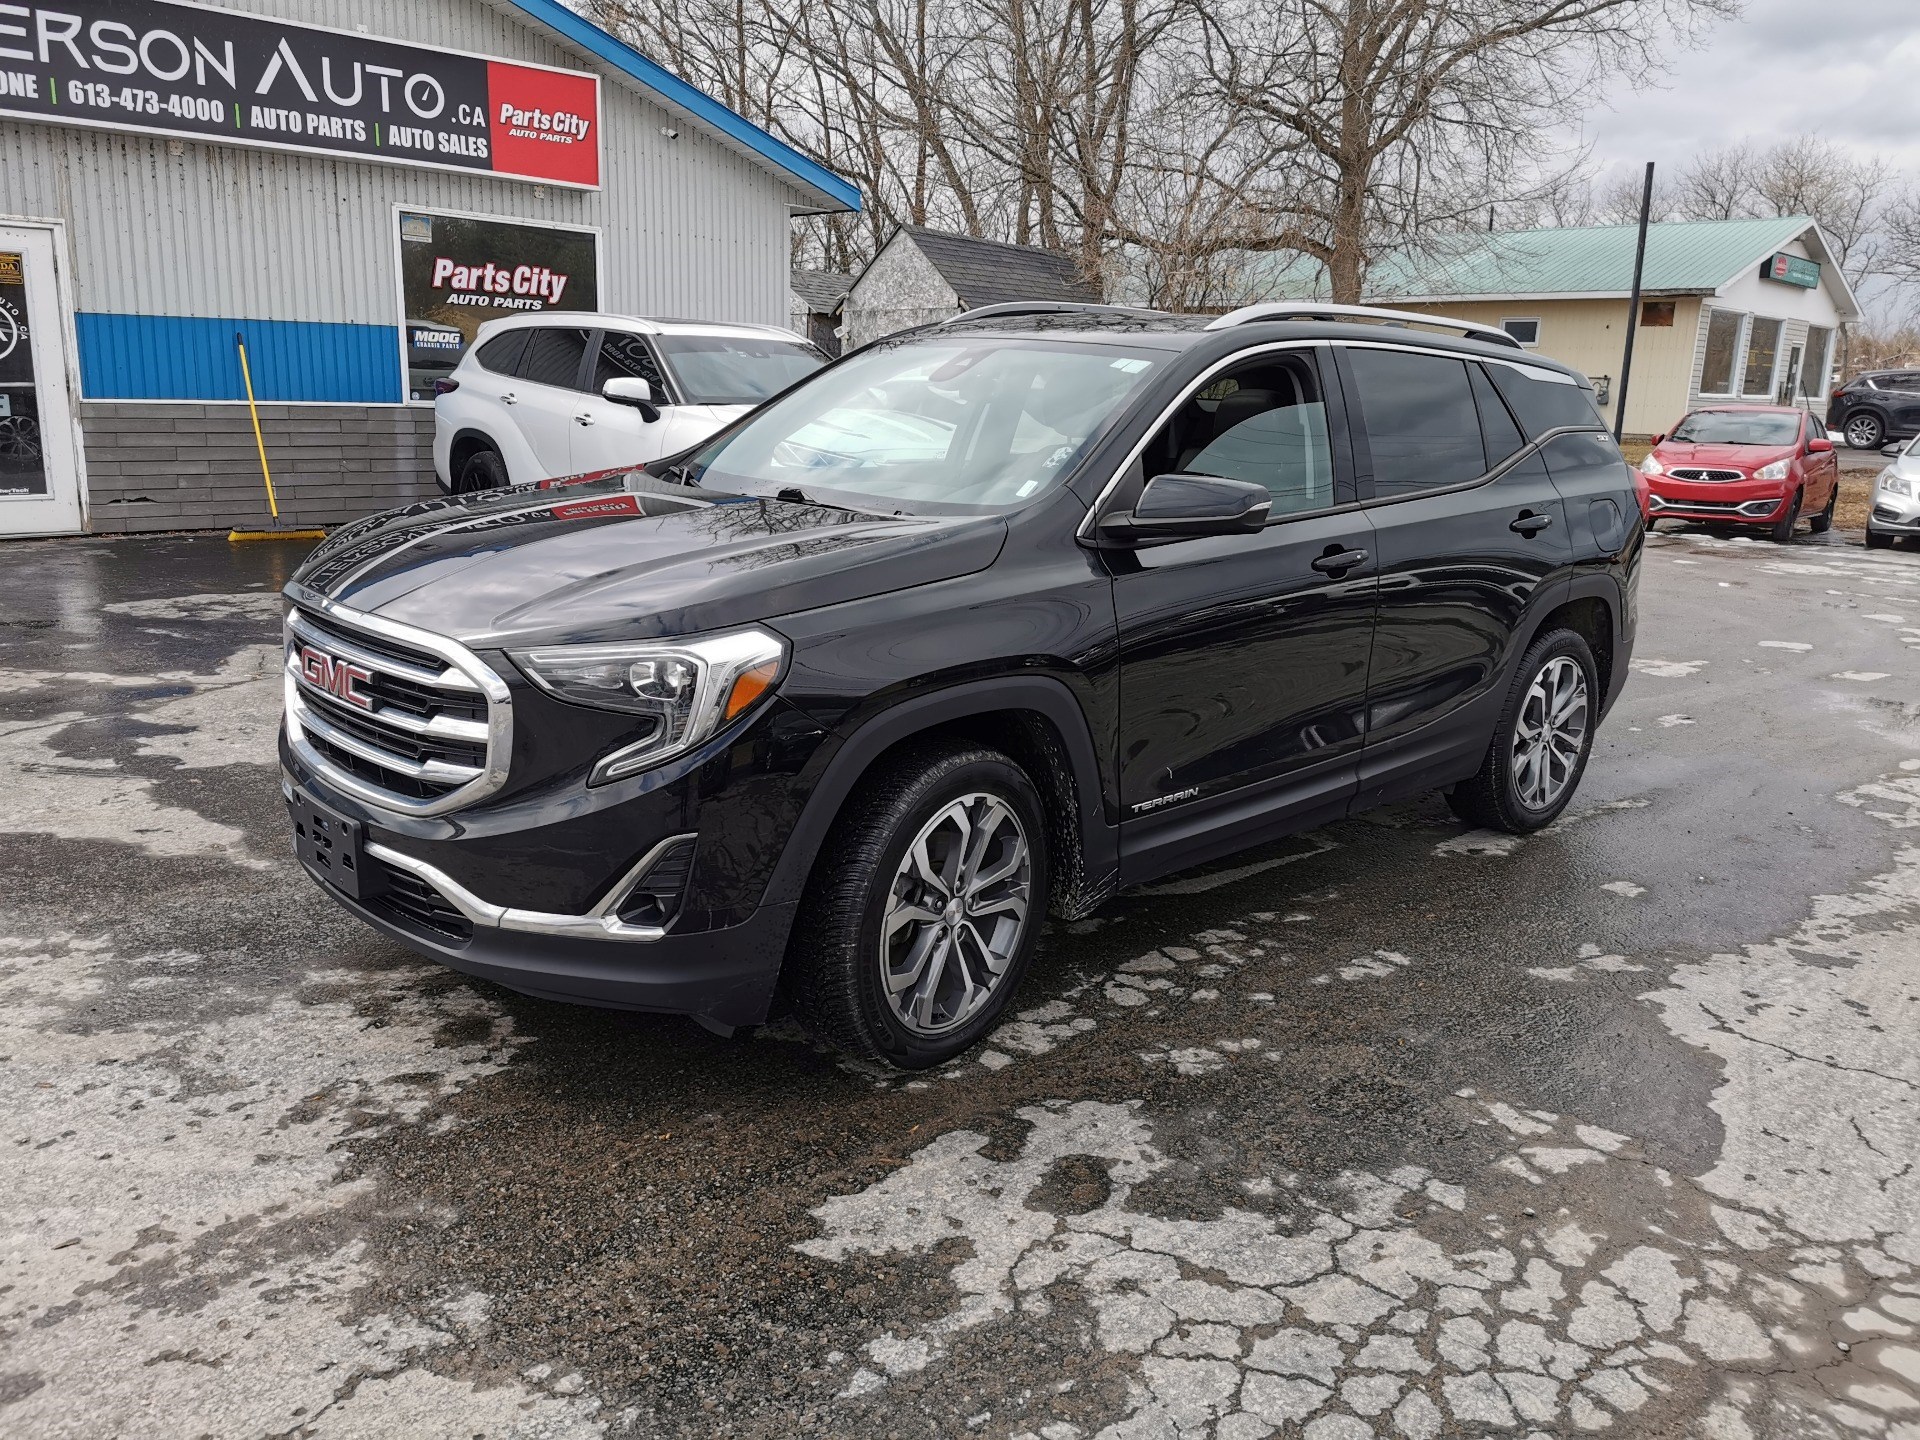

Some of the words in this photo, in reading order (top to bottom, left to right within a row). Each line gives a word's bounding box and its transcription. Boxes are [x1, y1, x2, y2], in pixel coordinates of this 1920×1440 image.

[0, 3, 236, 90] ERSON
[255, 37, 445, 119] AUTO
[68, 79, 225, 123] 613-473-4000
[250, 105, 302, 134] AUTO
[306, 112, 367, 142] PARTS
[388, 125, 435, 151] AUTO
[438, 131, 488, 159] SALES
[509, 128, 537, 139] AUTO
[539, 132, 573, 144] PARTS
[446, 293, 490, 307] AUTO
[493, 296, 543, 311] PARTS
[415, 330, 460, 344] MOOG
[301, 646, 373, 711] GMC
[1131, 787, 1199, 813] TERRAIN
